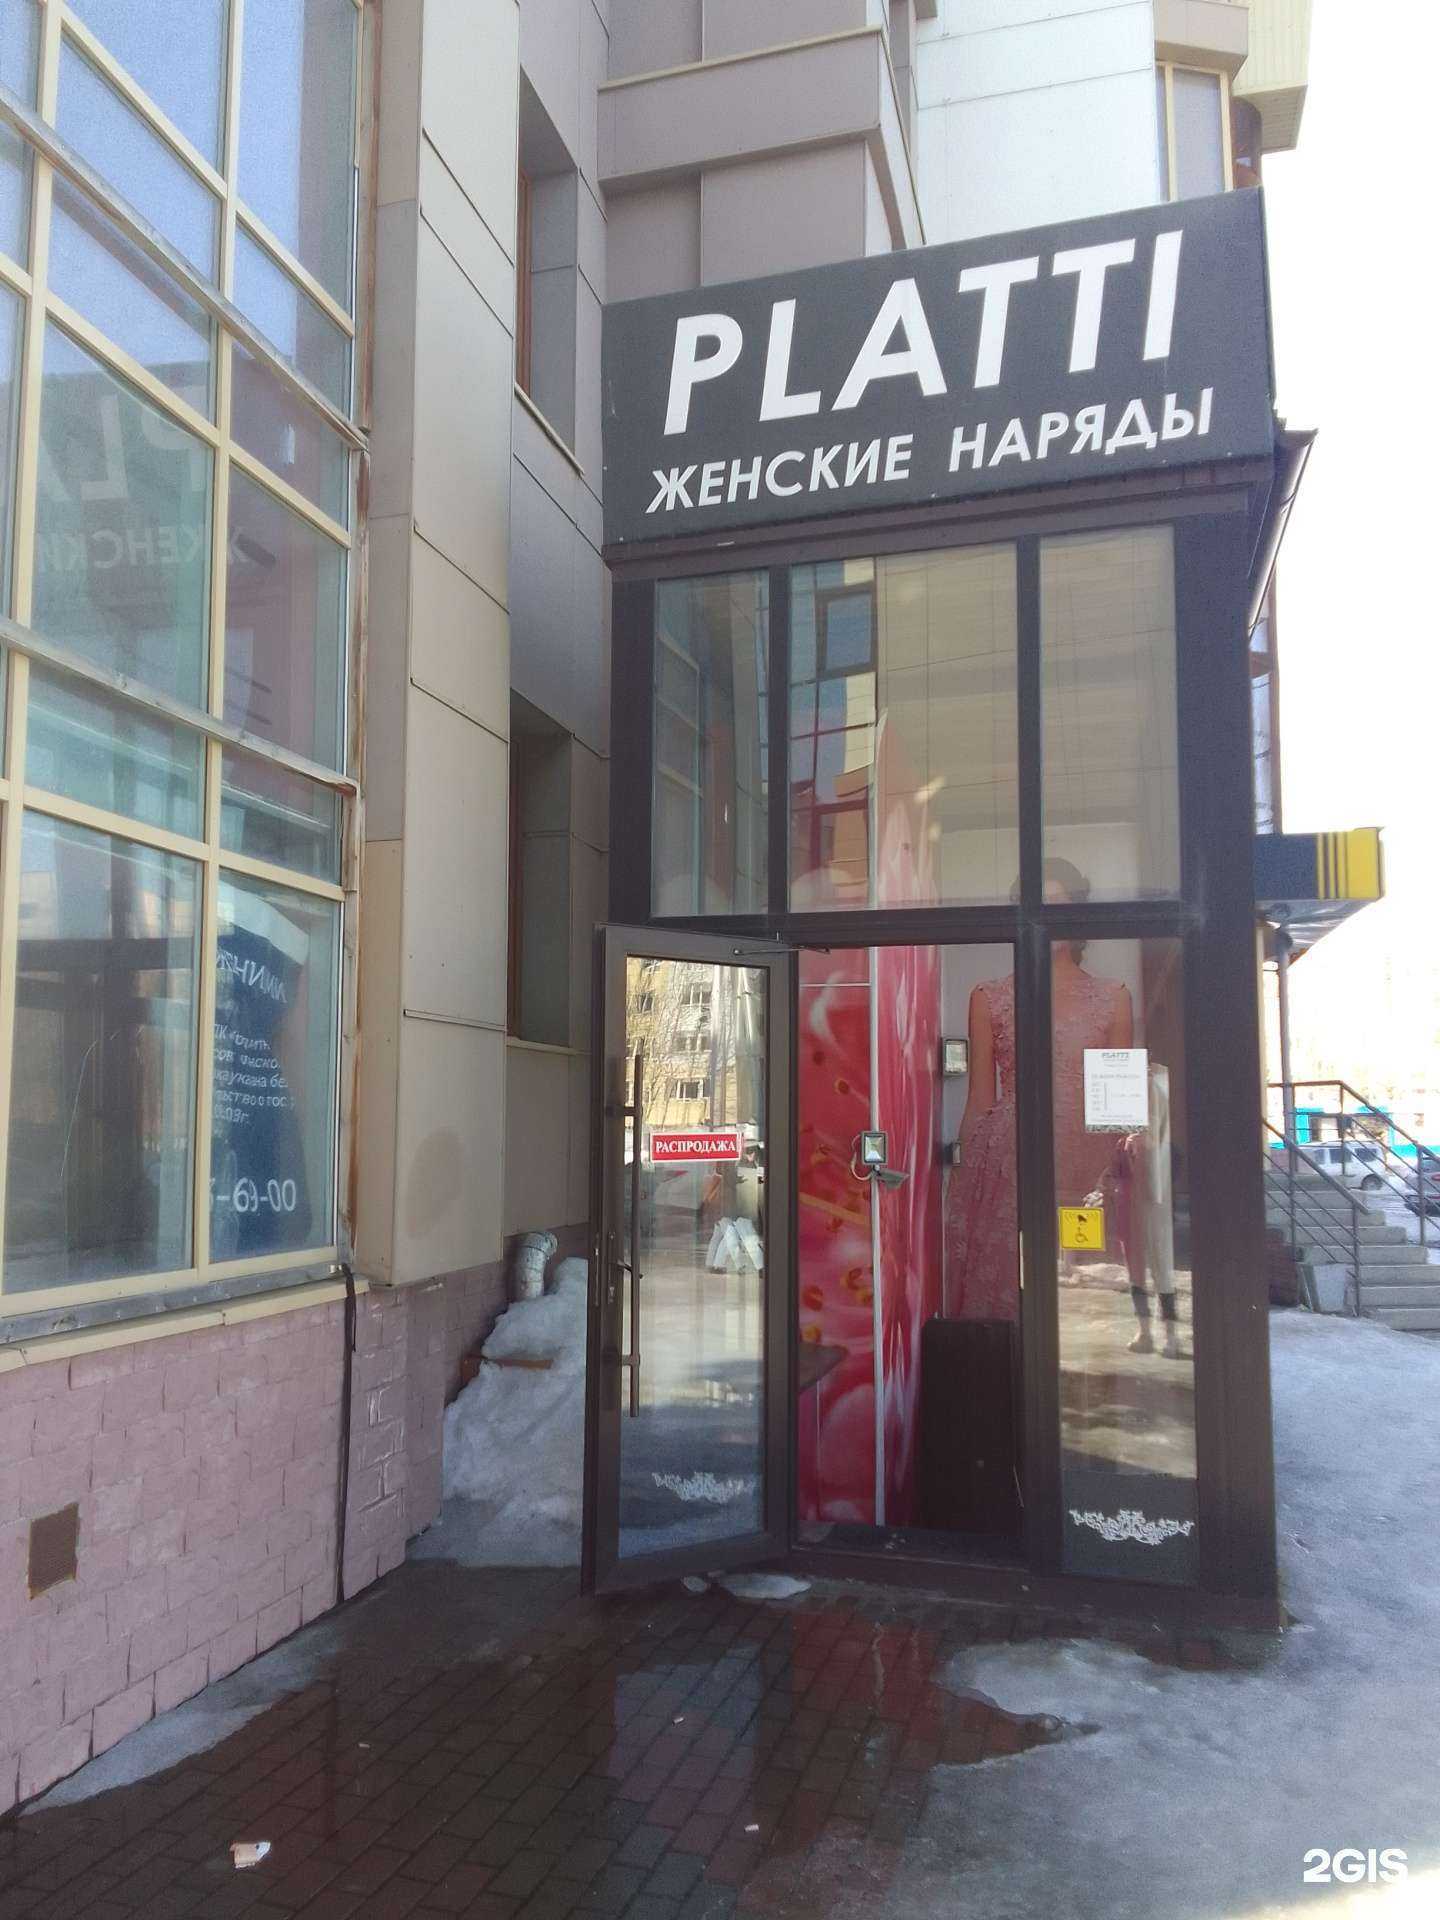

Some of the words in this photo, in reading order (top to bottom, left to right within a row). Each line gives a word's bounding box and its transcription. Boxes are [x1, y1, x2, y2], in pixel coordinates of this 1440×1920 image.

[664, 230, 1184, 436] PLATTI
[645, 434, 914, 514] ЖЕНСКИЕ
[948, 387, 1214, 473] НАРЯДЫ
[655, 1140, 737, 1154] РАСПРОДАЖА
